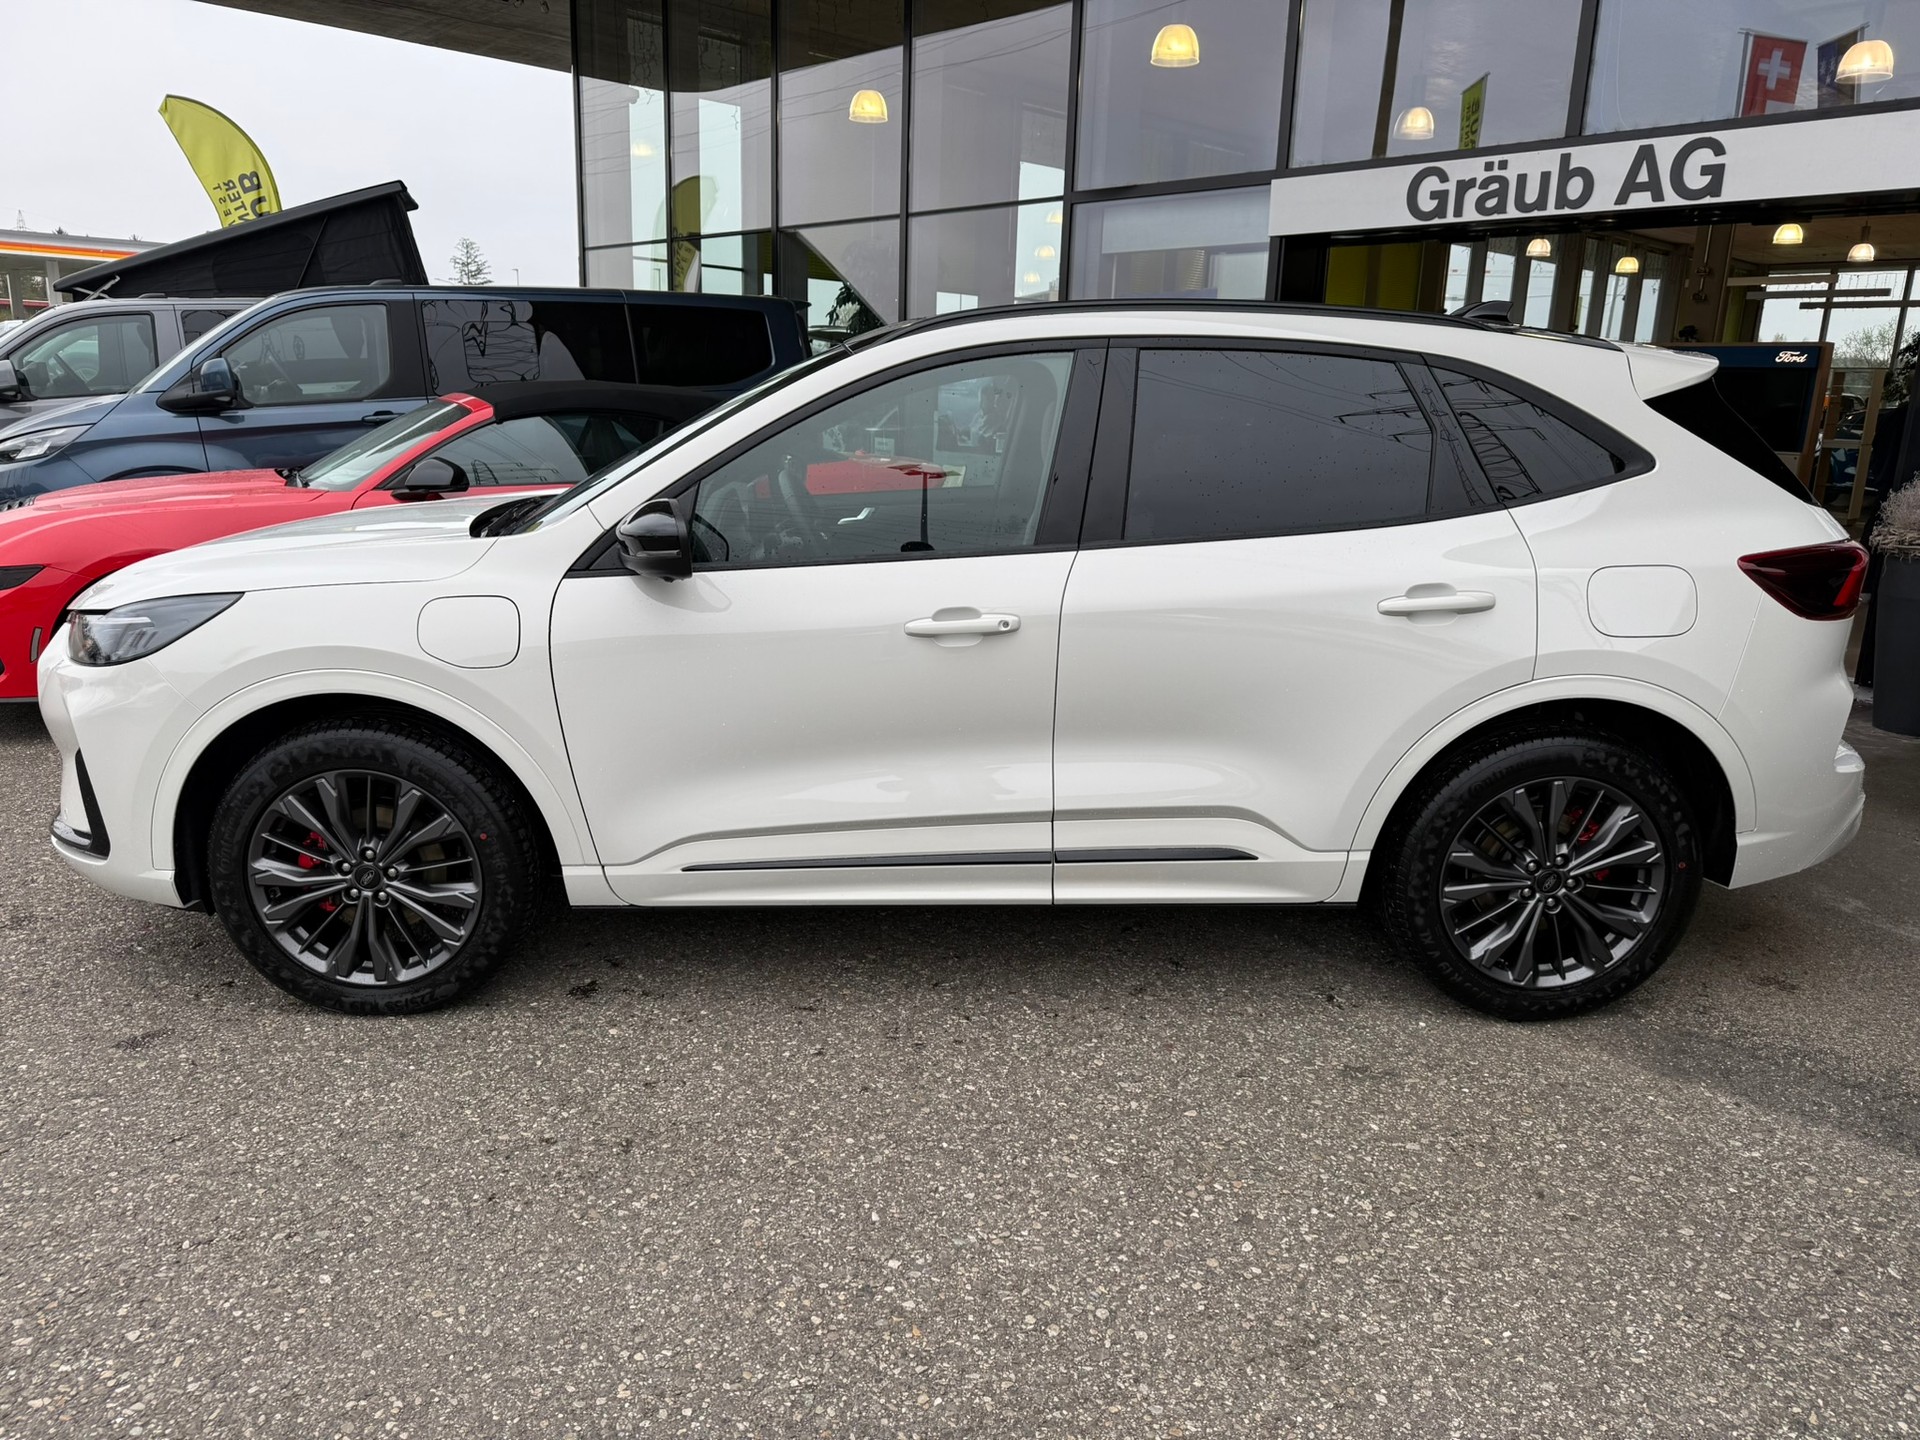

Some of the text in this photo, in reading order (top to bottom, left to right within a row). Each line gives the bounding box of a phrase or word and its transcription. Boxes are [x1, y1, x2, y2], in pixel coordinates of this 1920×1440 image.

[1406, 136, 1727, 221] Gräub AG
[1775, 351, 1808, 363] Ford
